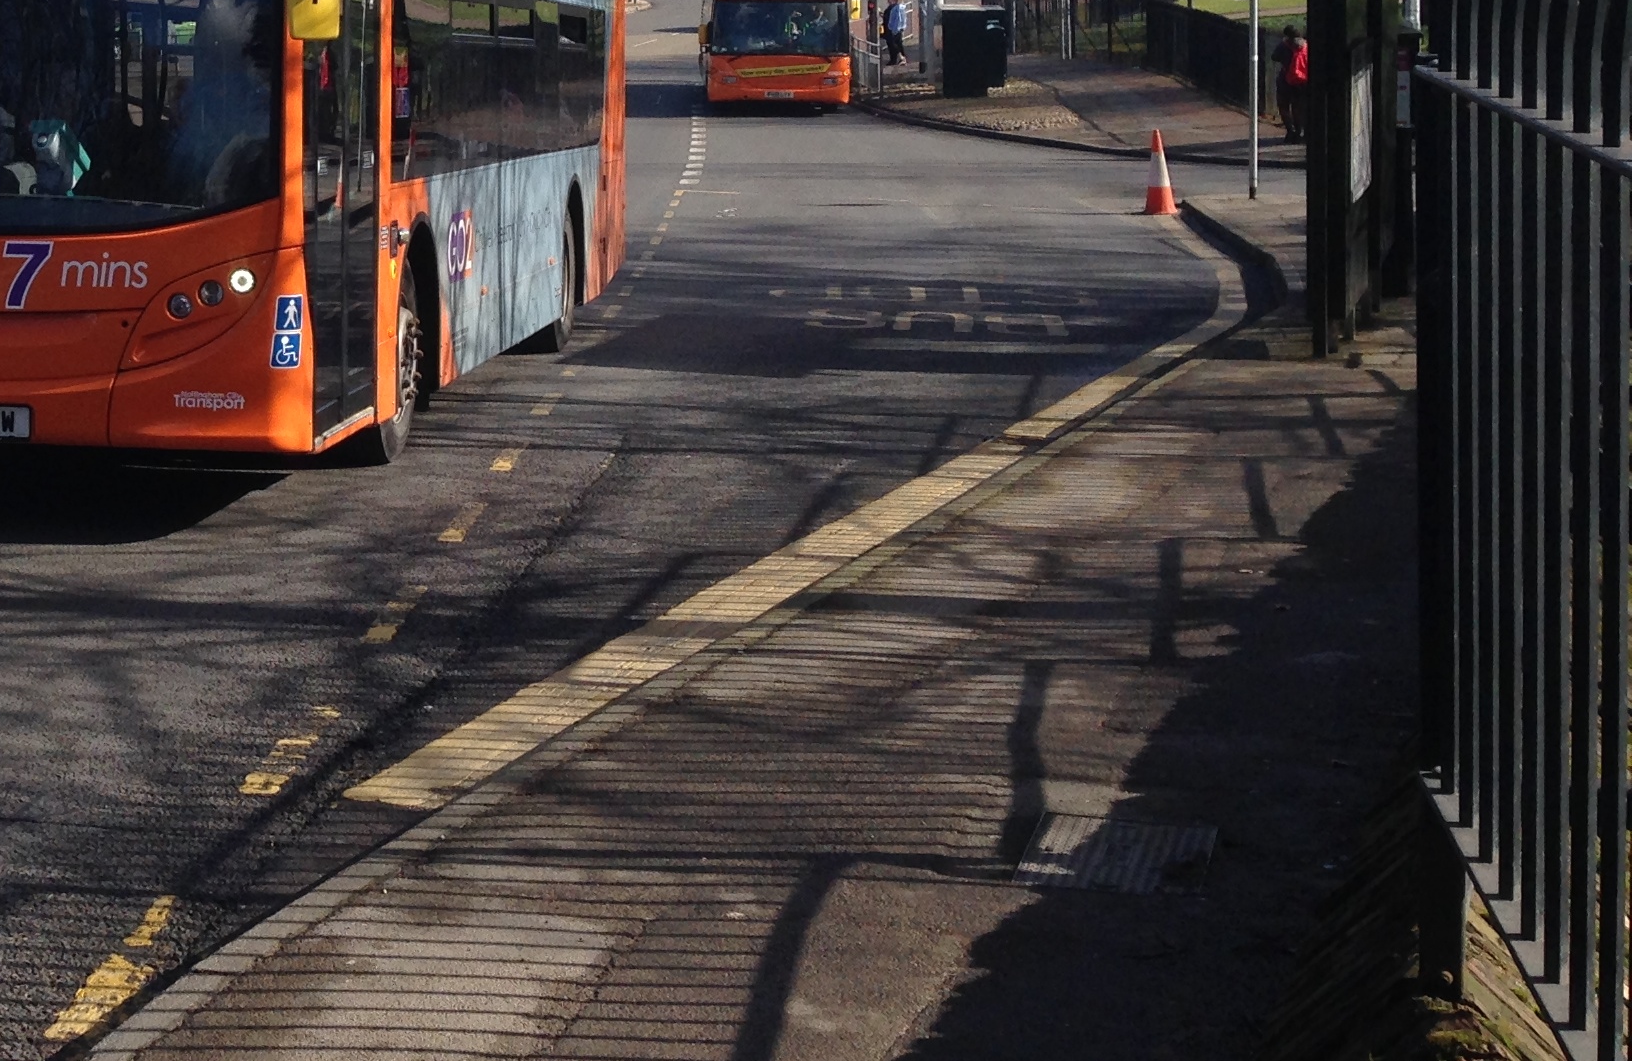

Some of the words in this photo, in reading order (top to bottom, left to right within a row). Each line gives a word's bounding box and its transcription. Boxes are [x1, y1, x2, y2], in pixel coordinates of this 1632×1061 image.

[2, 241, 53, 309] 7
[60, 259, 149, 289] mins
[448, 217, 473, 277] GO2
[173, 393, 246, 412] Transport
